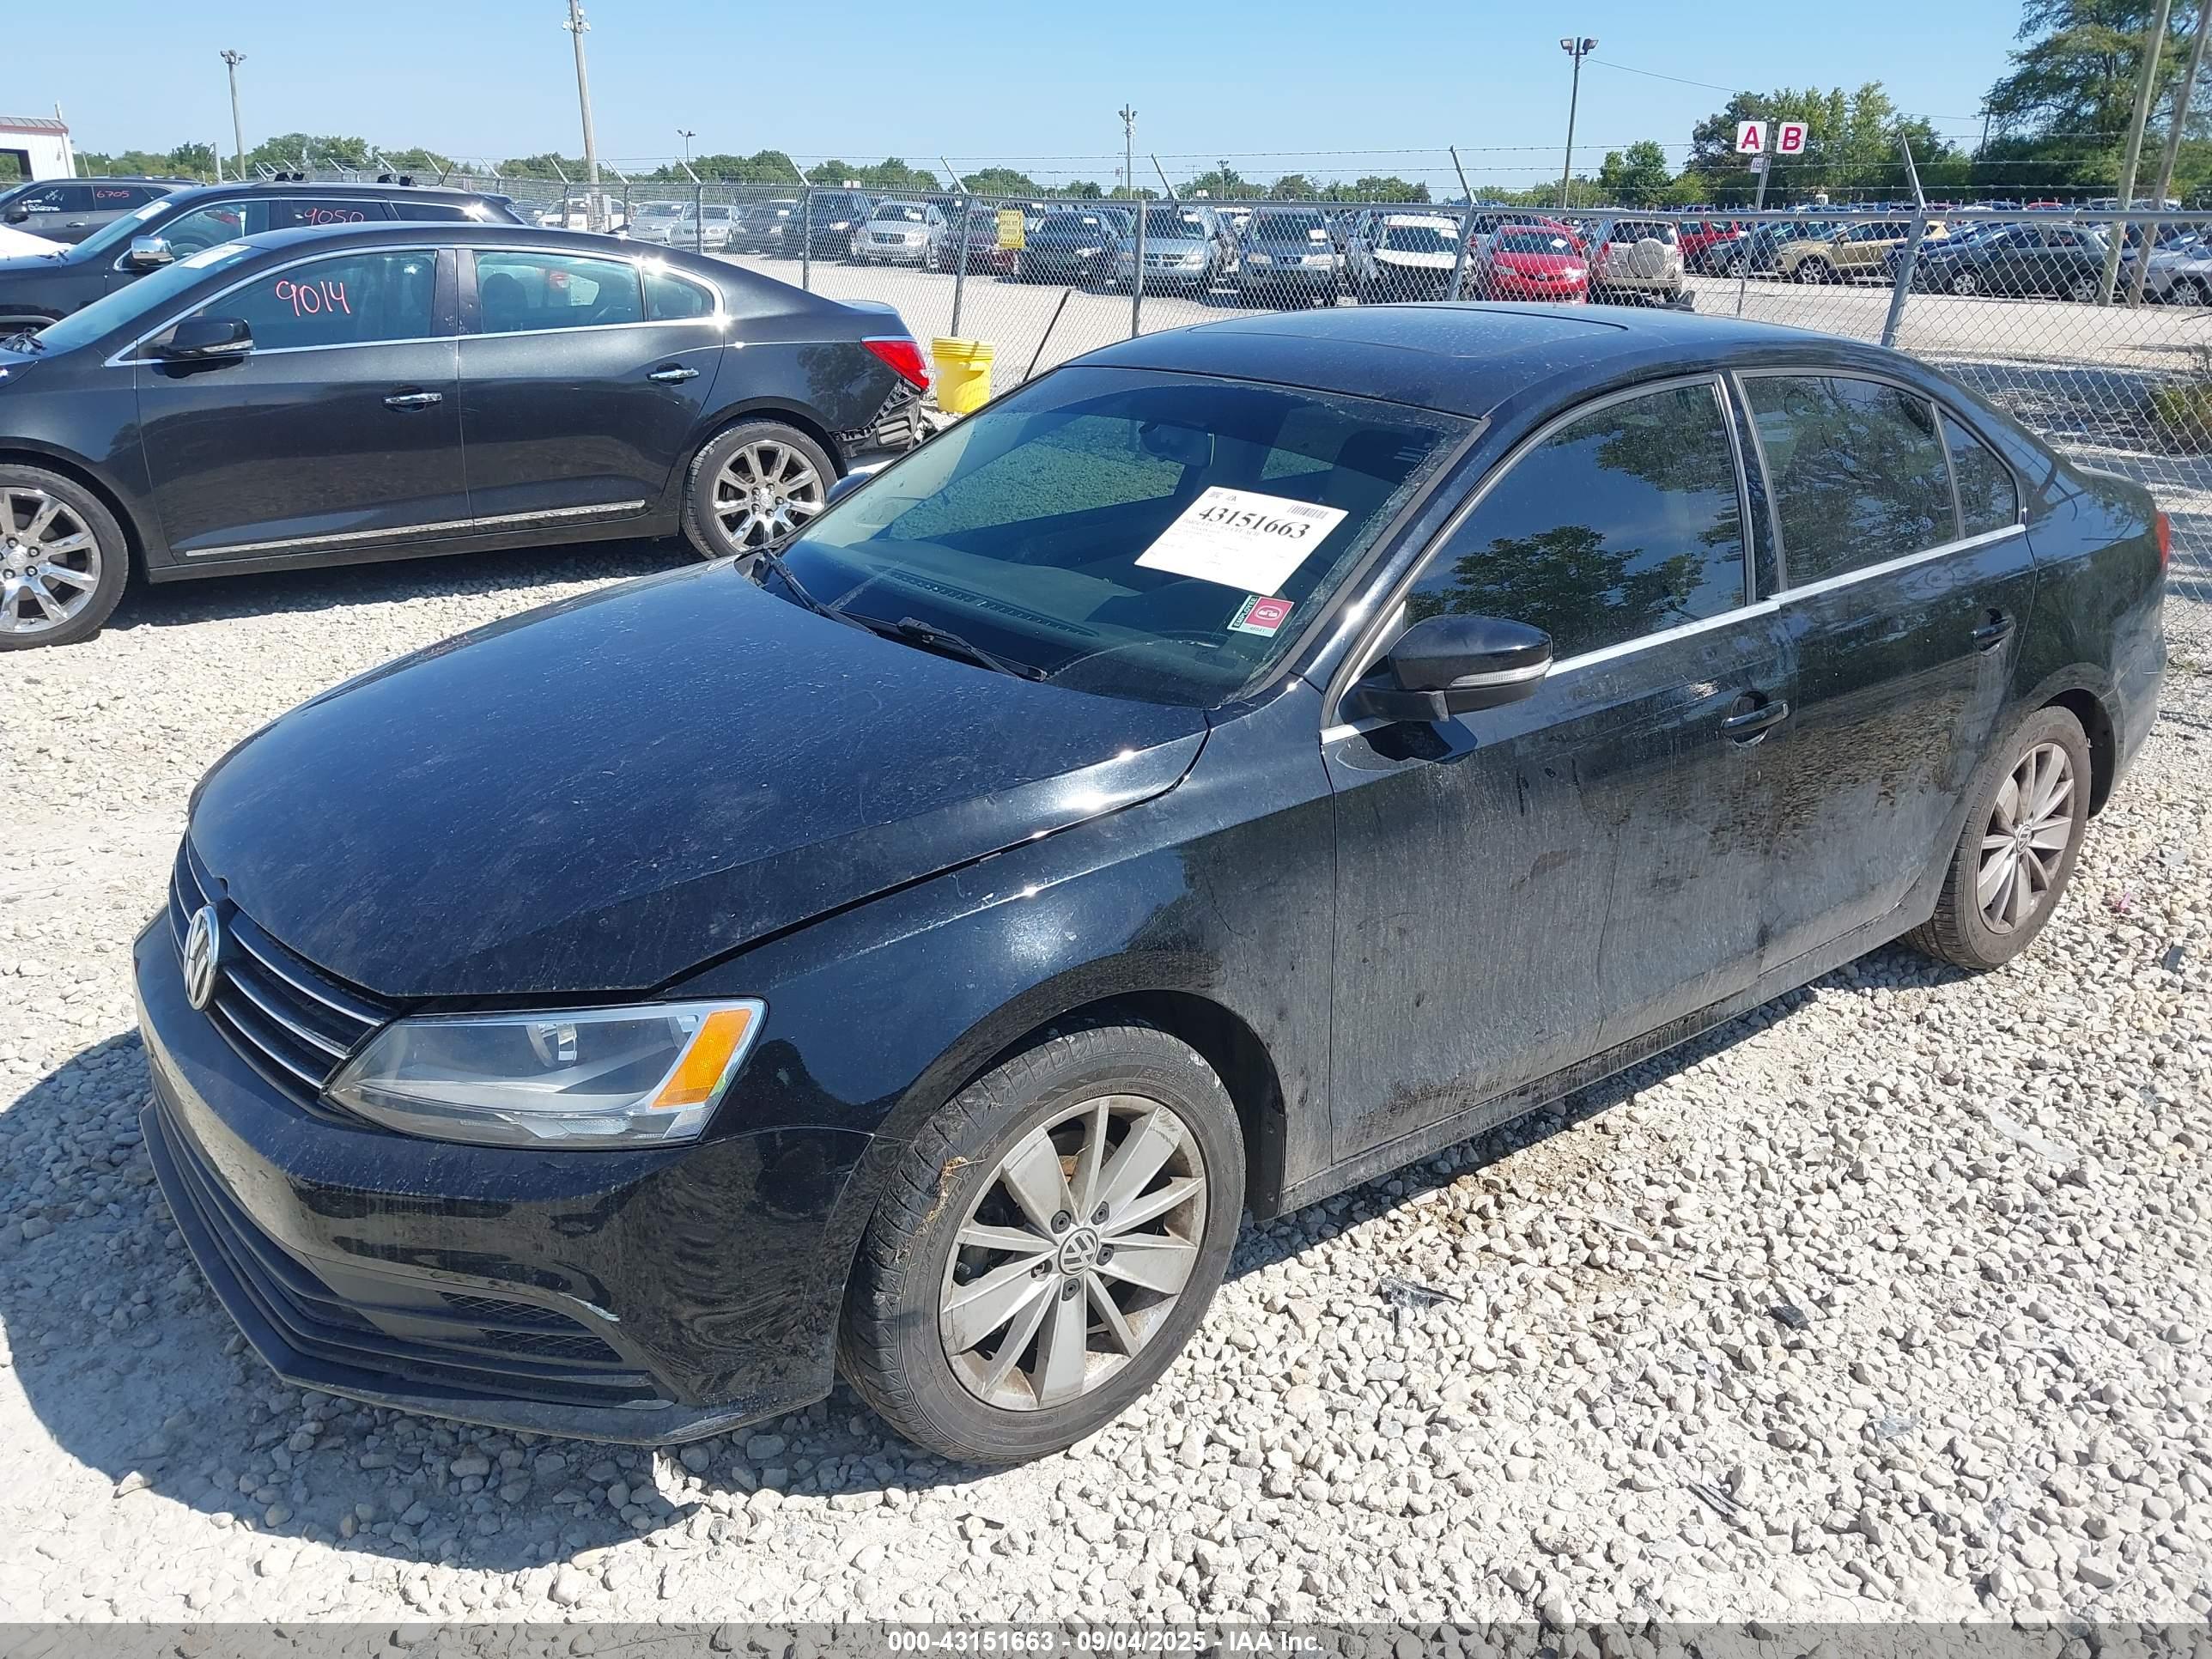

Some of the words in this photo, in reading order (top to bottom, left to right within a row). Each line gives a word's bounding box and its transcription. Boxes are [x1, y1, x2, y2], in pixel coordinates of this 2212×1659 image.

[1741, 125, 1760, 149] A
[1782, 126, 1802, 151] B
[96, 190, 131, 199] 6705
[304, 207, 365, 226] 9050
[276, 280, 351, 317] 9014
[1199, 506, 1310, 539] 43151663
[1233, 597, 1258, 628] EMPLOYEE
